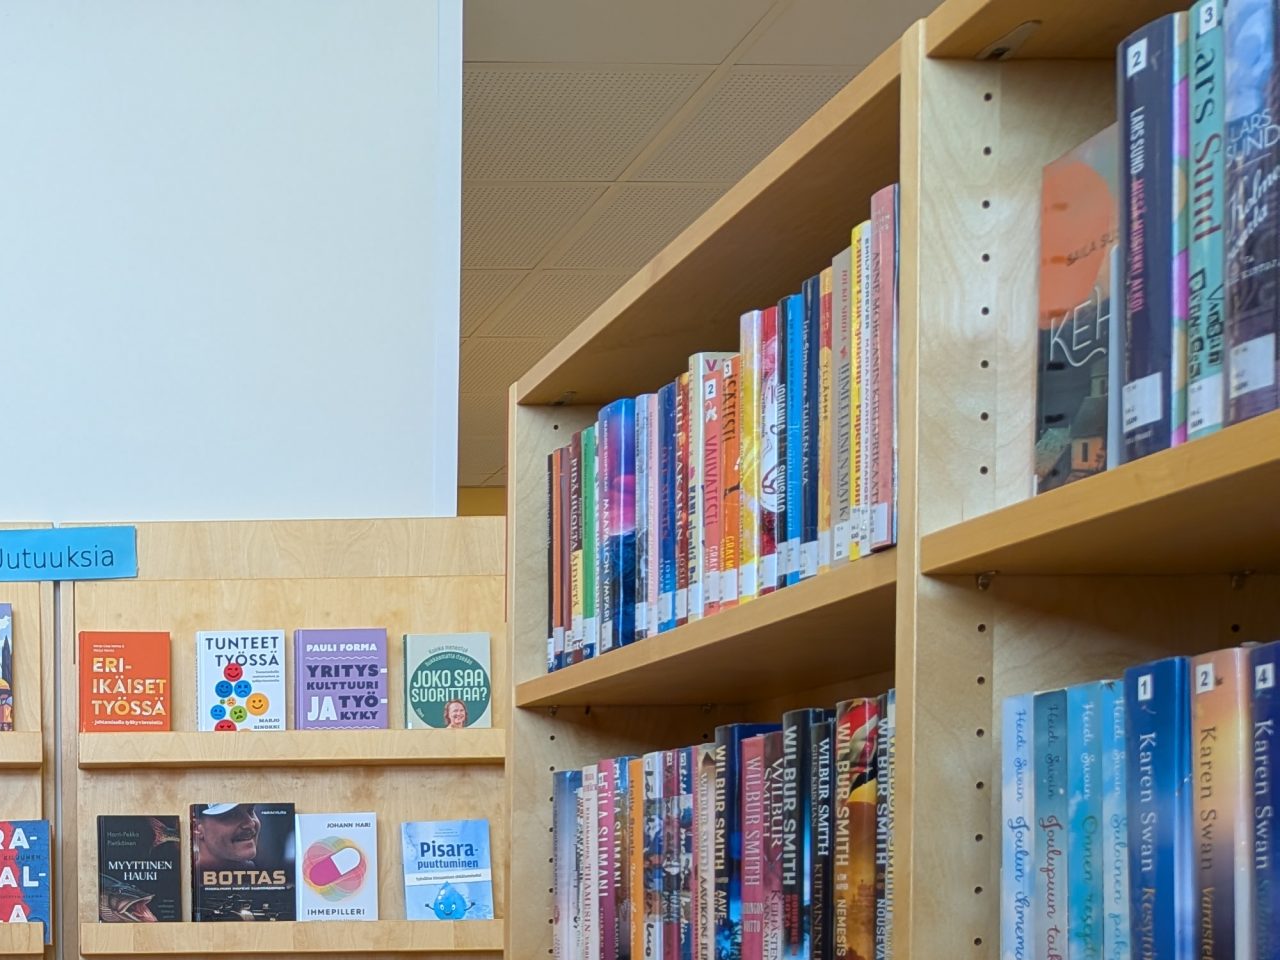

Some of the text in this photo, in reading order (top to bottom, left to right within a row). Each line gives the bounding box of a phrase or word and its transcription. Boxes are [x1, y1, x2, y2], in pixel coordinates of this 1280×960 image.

[1193, 132, 1224, 243] Sund
[204, 636, 279, 650] TUNTEET
[306, 643, 377, 652] PAULI FORMA
[92, 657, 133, 673] ERI-
[214, 650, 280, 667] TYÖSSÄ
[305, 663, 388, 678] YRITYS-
[92, 675, 167, 694] IKÄISET
[306, 680, 379, 690] KULTTUURI
[412, 668, 484, 688] JOKO SAA
[1140, 679, 1149, 697] 1
[1200, 671, 1210, 687] 2
[91, 696, 167, 716] TYÖSSÄ
[338, 691, 388, 708] TYÖ-
[411, 687, 488, 703] SUORITTAA?
[307, 696, 338, 721] JA
[339, 710, 379, 721] KYKY
[1046, 702, 1061, 747] Heidi
[782, 724, 798, 812] WILBUR
[1138, 731, 1158, 803] Karen
[1199, 726, 1218, 801] Karen
[1254, 719, 1275, 798] Karen
[1045, 752, 1061, 801] Swain
[770, 757, 784, 849] WILBUR
[816, 737, 831, 856] WILBUR SMITH
[876, 717, 888, 865] WILBUR SMITH
[1007, 707, 1032, 885] Heidi Swain Joulun
[1080, 701, 1099, 886] Heidi Swain Onnen
[714, 744, 727, 870] WILBUR SMITH
[744, 755, 763, 886] WILBUR SMITH
[420, 840, 480, 858] Pisara-
[835, 722, 852, 957] WILBUR SMITH NEMESIS
[1140, 810, 1158, 873] Swan
[1199, 807, 1218, 871] Swan
[1254, 804, 1275, 871] Swan
[783, 818, 798, 885] SMITH
[108, 860, 172, 870] MYYTTINEN
[123, 871, 158, 880] HAUKI
[417, 858, 480, 871] puuttuminen
[1038, 814, 1065, 919] Joulupuun
[203, 870, 286, 885] BOTTAS
[307, 908, 365, 916] IHMEPILLERI
